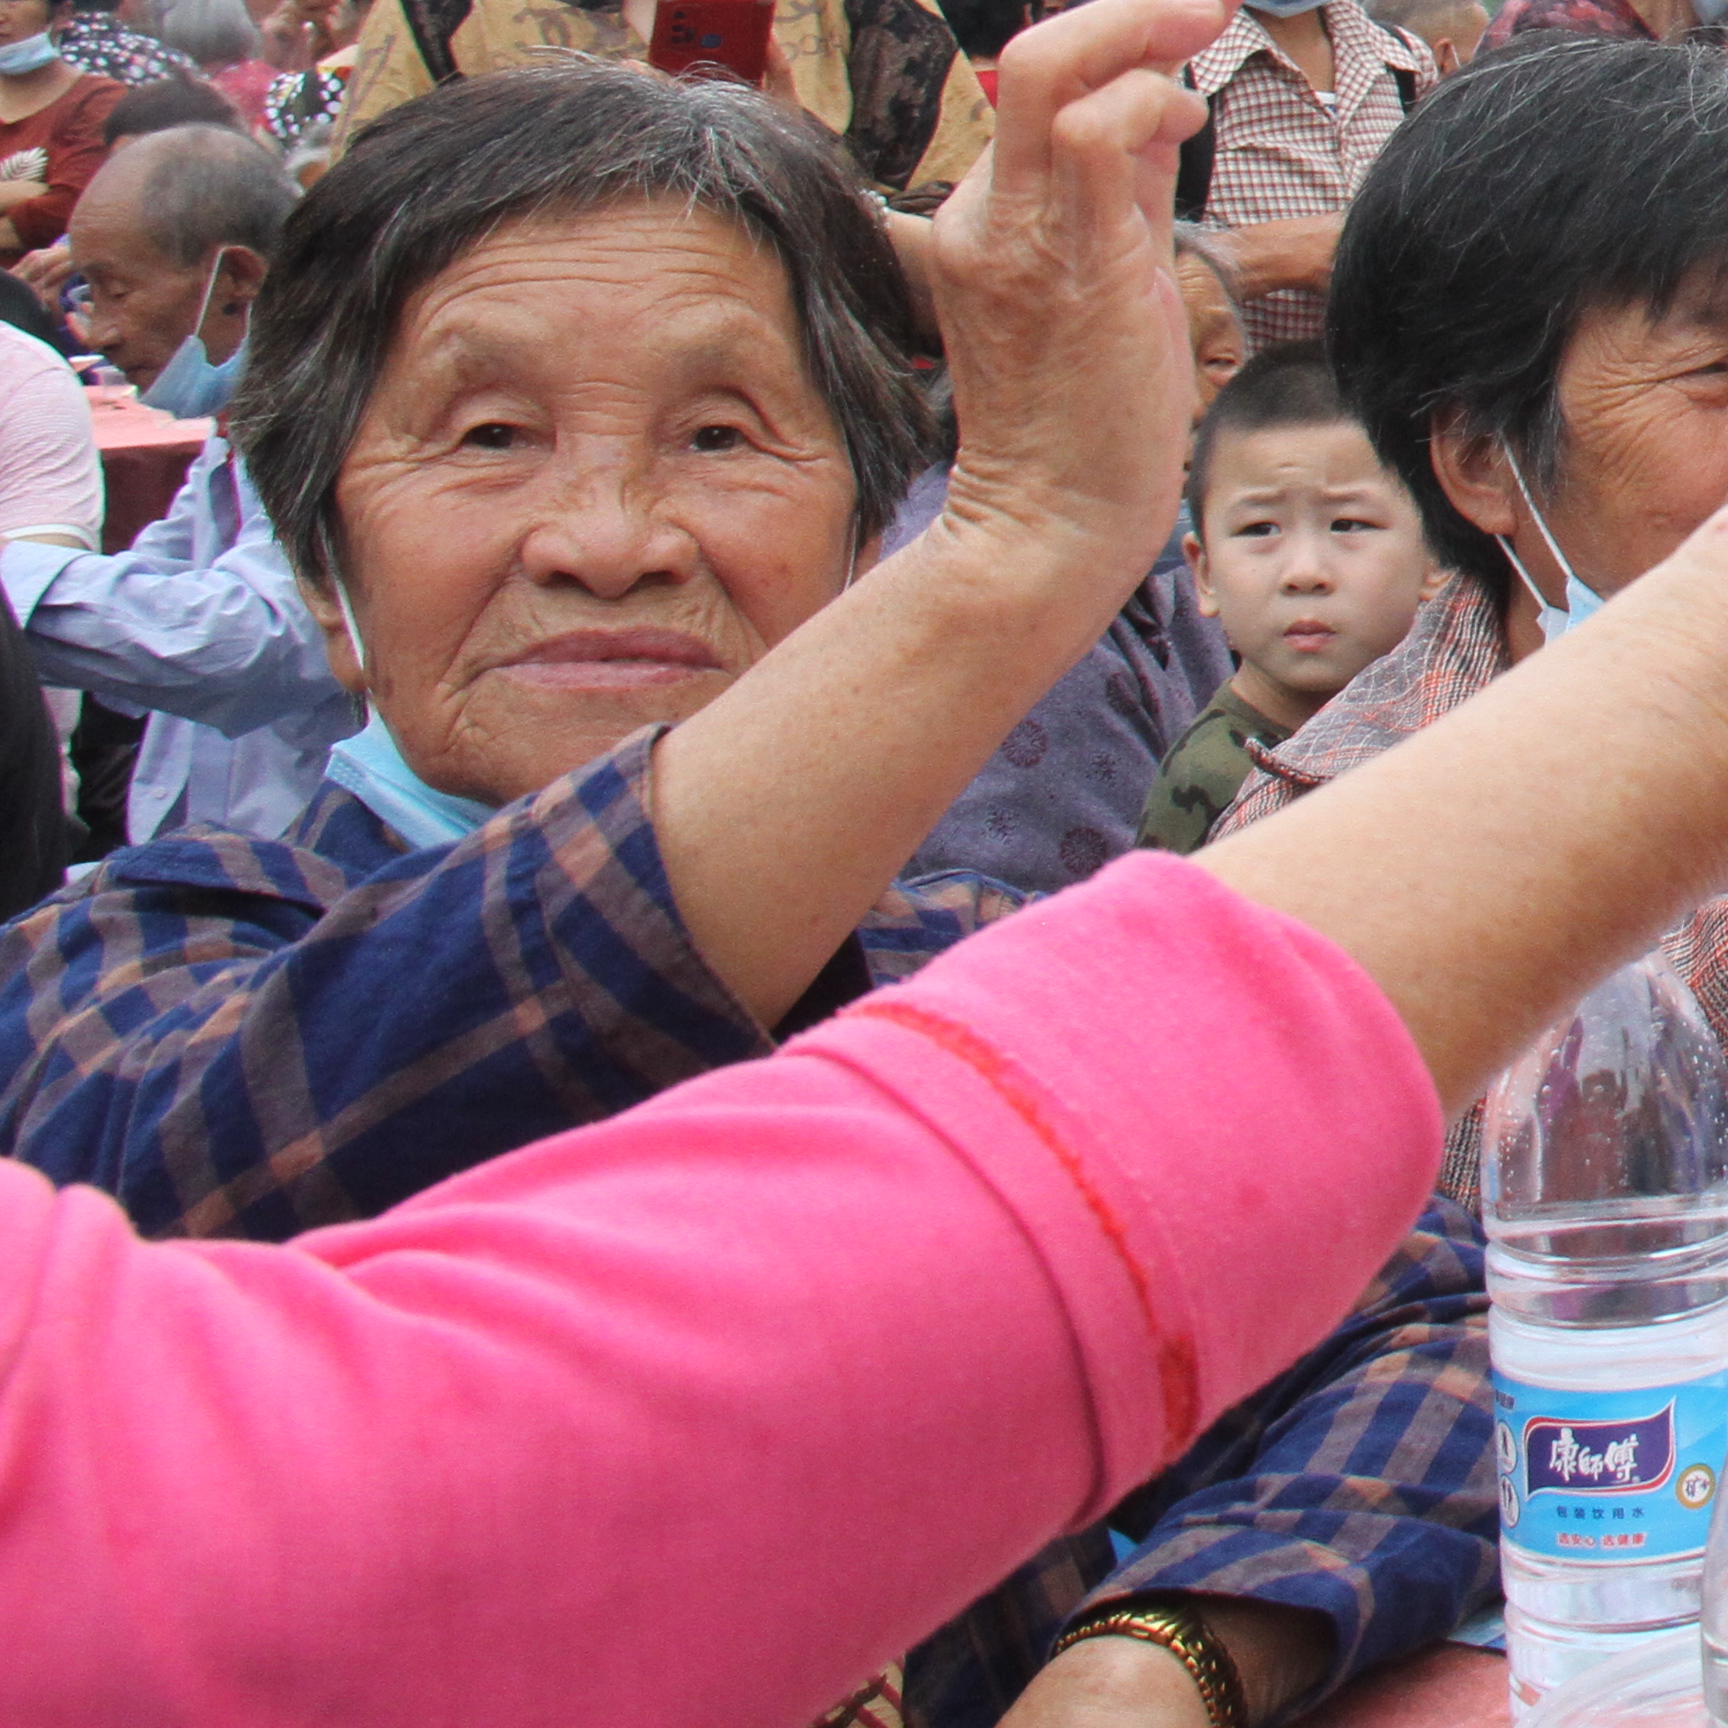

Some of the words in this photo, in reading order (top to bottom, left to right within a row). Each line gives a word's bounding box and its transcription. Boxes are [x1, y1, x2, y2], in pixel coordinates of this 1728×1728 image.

[1549, 1427, 1639, 1483] 康師傅
[1556, 1505, 1645, 1520] 包装饮用水
